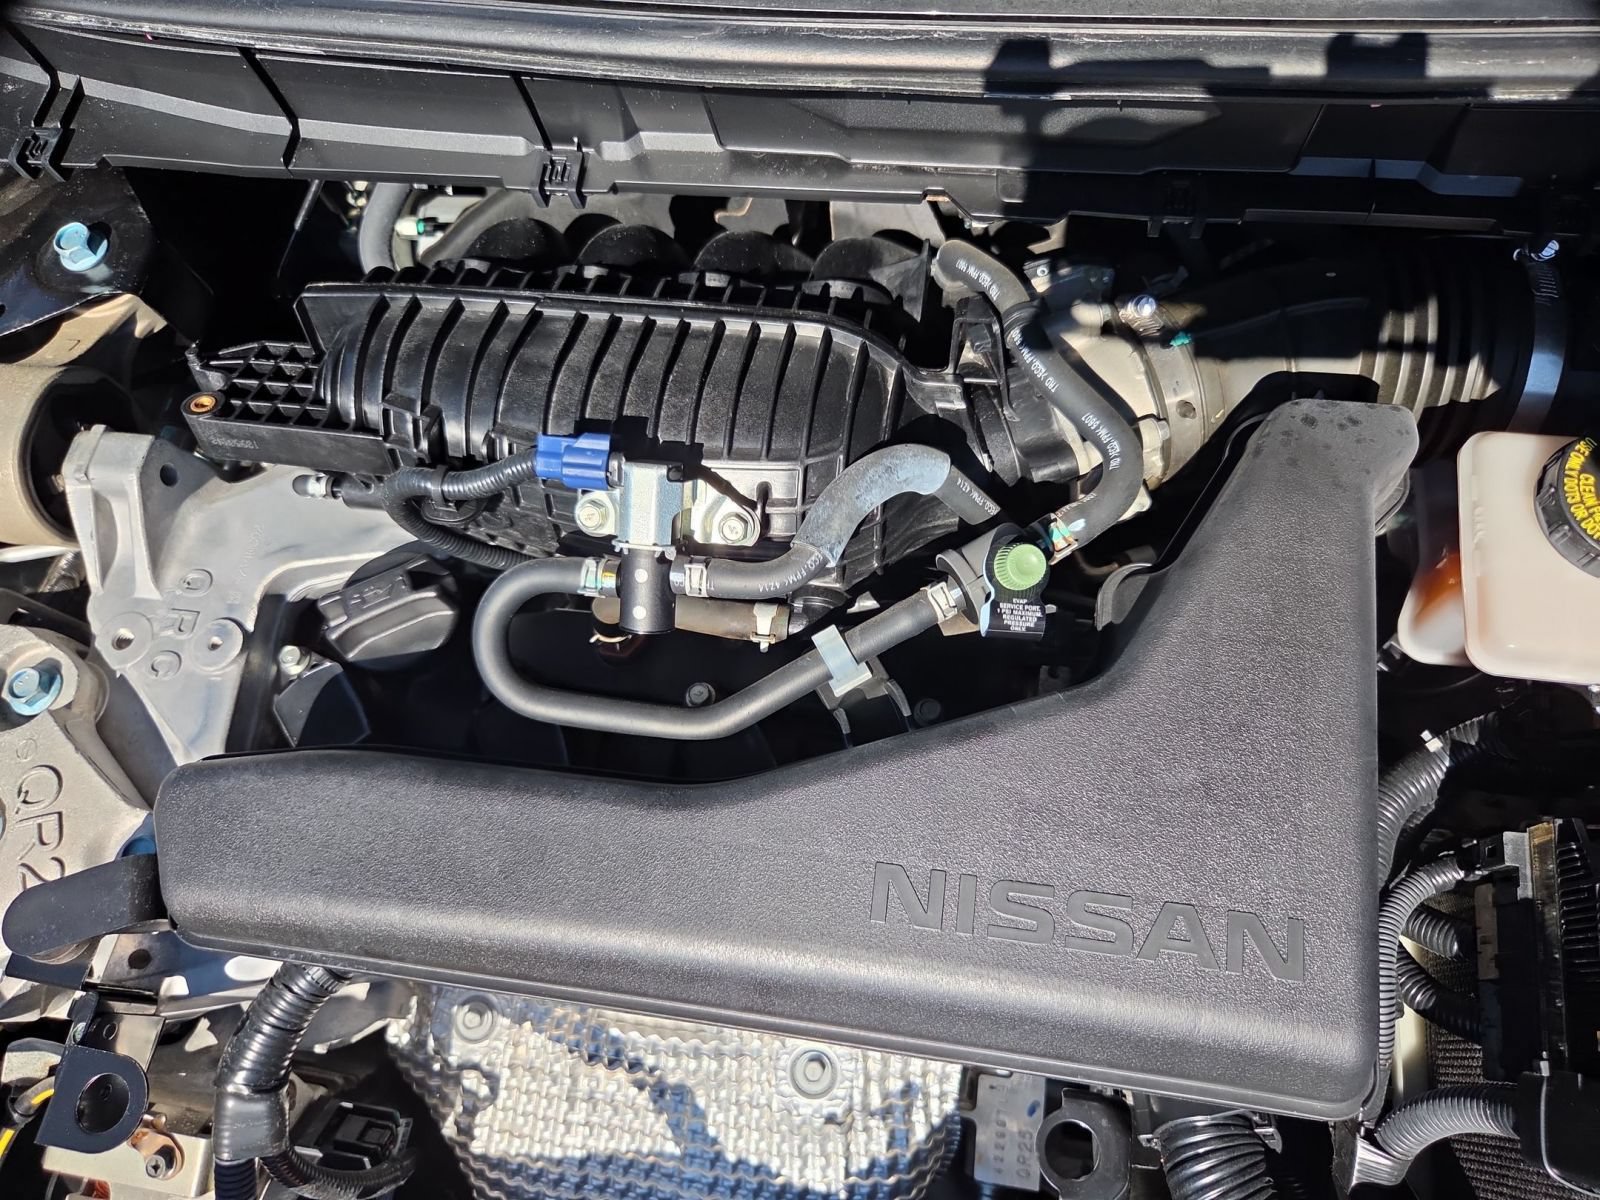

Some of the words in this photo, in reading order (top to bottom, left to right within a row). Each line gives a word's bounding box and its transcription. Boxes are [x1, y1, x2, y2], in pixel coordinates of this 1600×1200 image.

[1575, 437, 1598, 456] USE
[1564, 451, 1585, 478] ONLY
[1579, 473, 1598, 508] CLEAN
[1570, 503, 1588, 521] OR
[999, 602, 1024, 610] SERVICE
[1002, 614, 1038, 622] REGULATED
[1003, 620, 1035, 628] PRESSURE
[869, 861, 1306, 984] NISSAN
